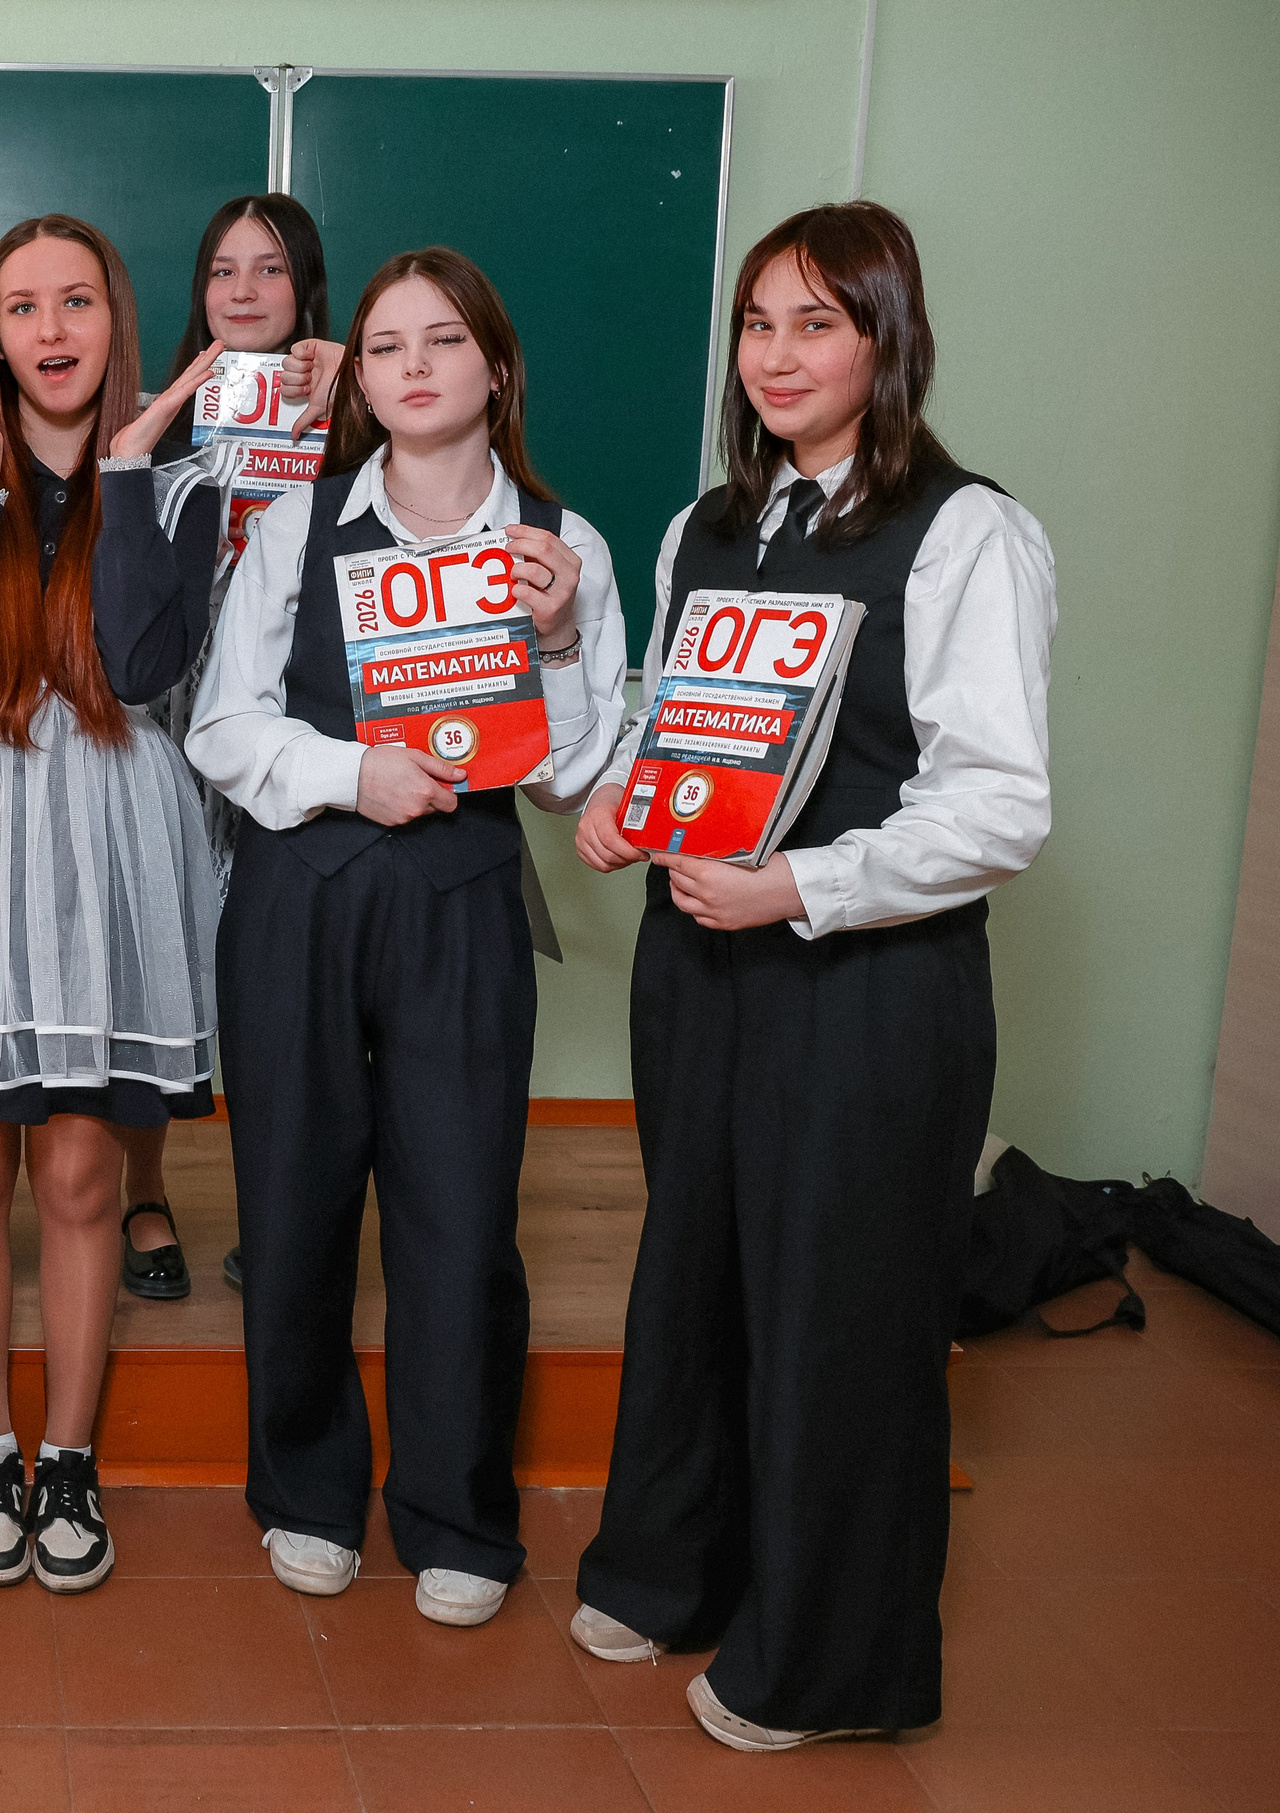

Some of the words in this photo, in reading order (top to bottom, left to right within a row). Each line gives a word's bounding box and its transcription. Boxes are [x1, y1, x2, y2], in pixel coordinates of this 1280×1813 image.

[202, 385, 221, 421] 2026
[377, 554, 398, 562] ПРОЕКТ
[350, 568, 373, 579] ФИПИ
[380, 547, 518, 628] ОГЭ
[355, 589, 379, 633] 2026
[716, 596, 735, 604] ПРОЕКТ
[768, 599, 810, 608] РАЗРАБОТЧИКОВ
[379, 646, 412, 657] ОСНОВНОЙ
[413, 638, 474, 652] ГОСУДАРСТВЕННЫЙ
[475, 634, 504, 643] ЭКЗАМЕН
[674, 626, 700, 671] 2026
[697, 605, 828, 679] ОГЭ
[371, 649, 521, 686] МАТЕМАТИКА
[387, 691, 414, 702] ТИПОВЫЕ
[416, 684, 474, 698] ЭКЗАМЕНАЦИОННЫЕ
[477, 680, 508, 690] ВАРИАНТЫ
[676, 690, 701, 698] ОСНОВНОЙ
[702, 692, 753, 702] ГОСУДАРСТВЕННЫЙ
[421, 701, 458, 711] РЕДАКЦИЕЙ
[660, 707, 781, 736] МАТЕМАТИКА
[444, 730, 463, 746] 36
[663, 737, 683, 745] ТИПОВЫЕ
[684, 738, 731, 750] ЭКЗАМЕНАЦИОННЫЕ
[732, 744, 761, 753] ВАРИАНТЫ
[681, 753, 711, 762] РЕДАКЦИЕЙ
[683, 785, 700, 801] 36
